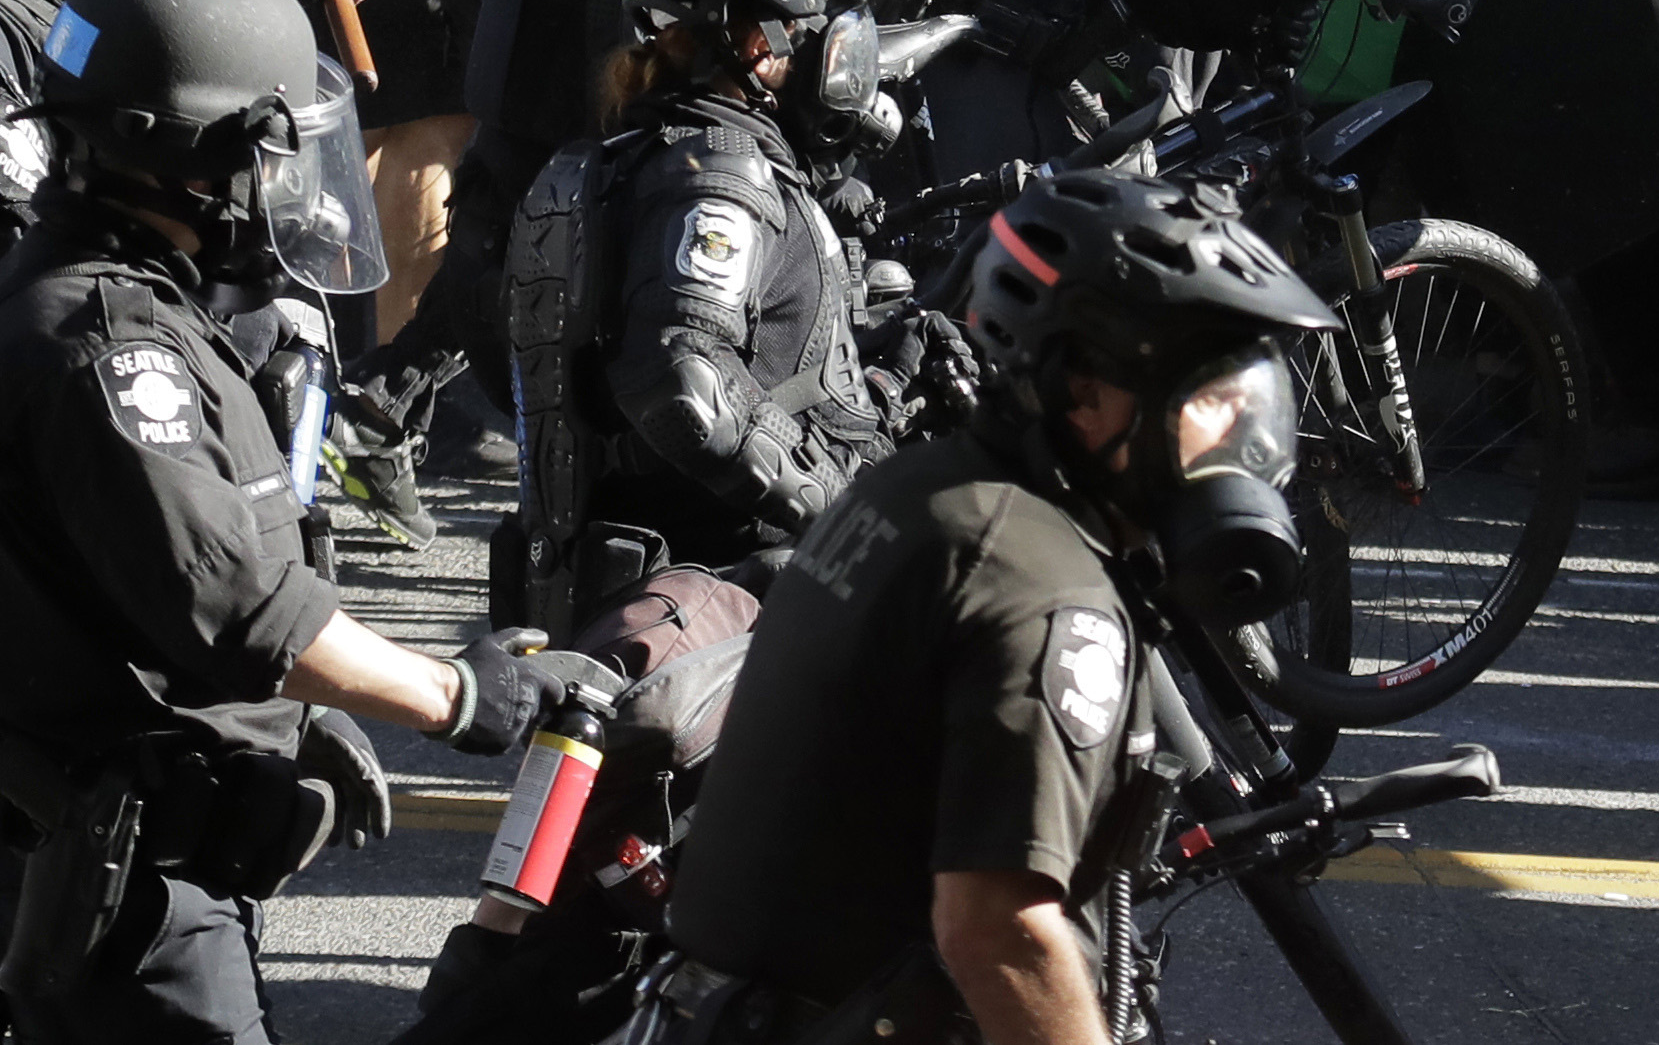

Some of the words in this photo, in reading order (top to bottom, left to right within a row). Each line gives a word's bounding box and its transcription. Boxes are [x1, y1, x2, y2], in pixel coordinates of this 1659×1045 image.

[110, 349, 181, 377] SEATTLE
[1550, 334, 1577, 421] SERFAS
[138, 420, 192, 444] POLICE
